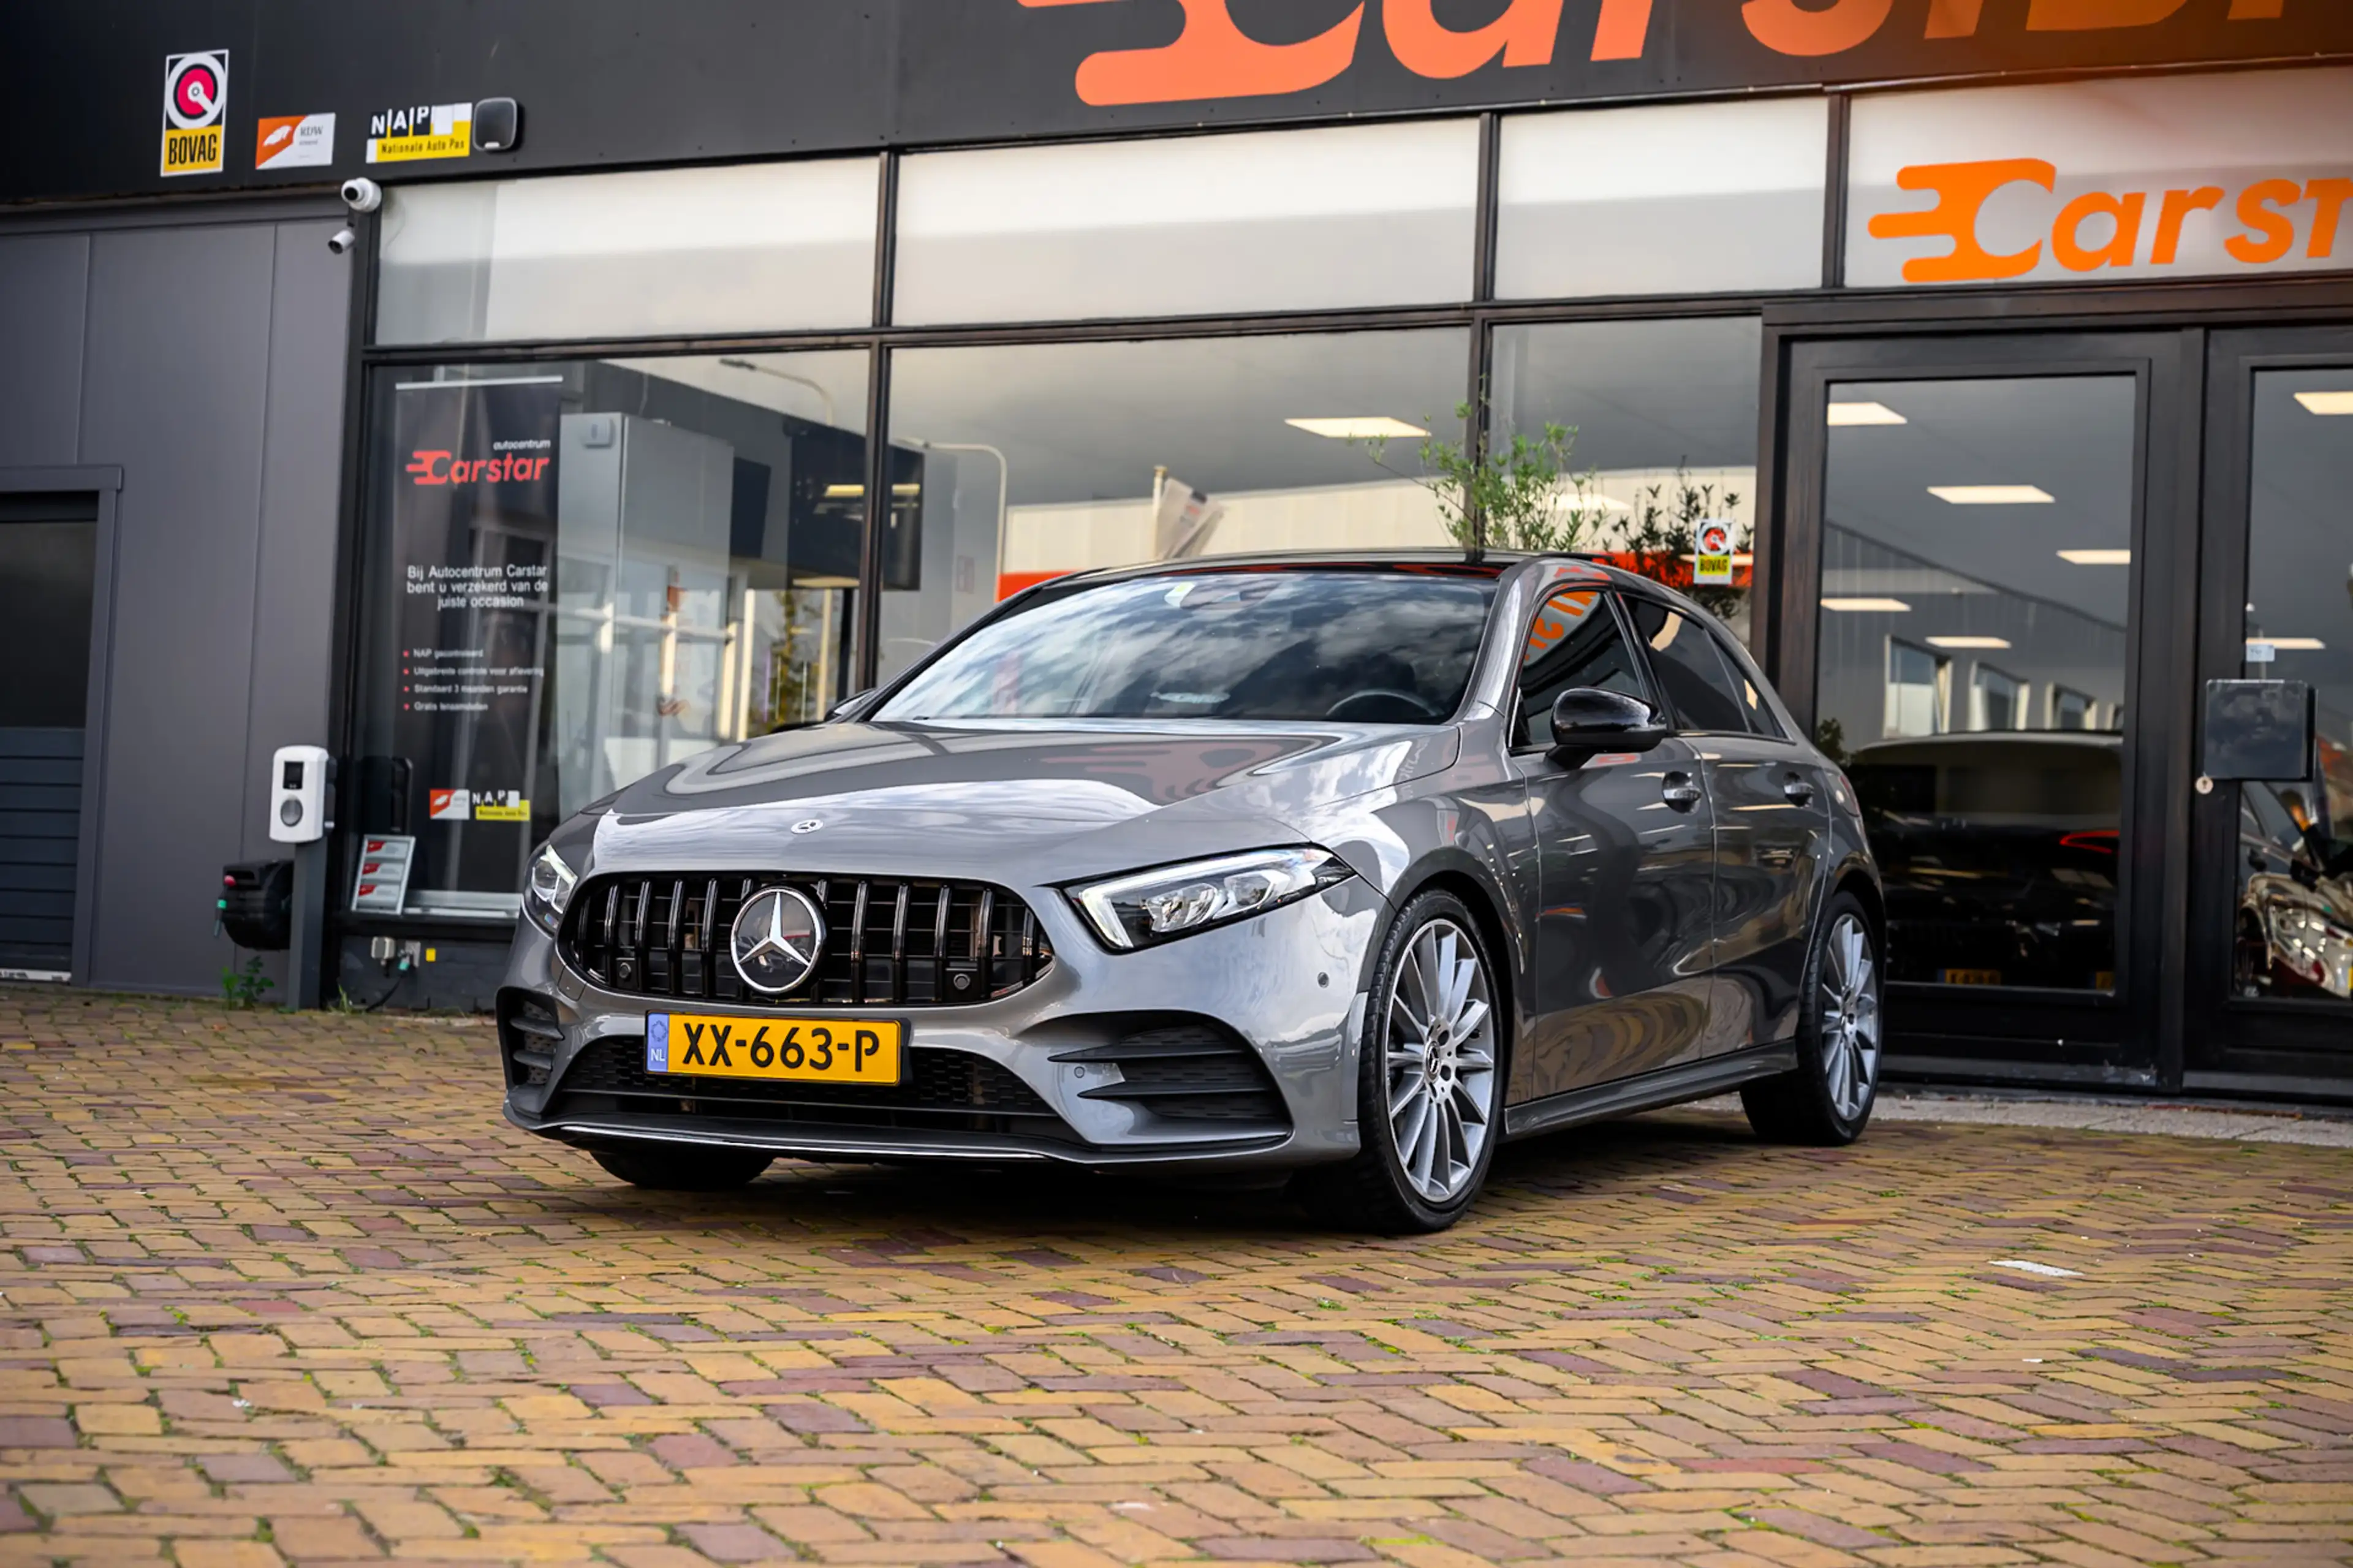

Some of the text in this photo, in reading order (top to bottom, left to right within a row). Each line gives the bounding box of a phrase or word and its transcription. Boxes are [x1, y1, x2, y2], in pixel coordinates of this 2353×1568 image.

[169, 133, 218, 165] BOVAG
[381, 138, 464, 154] Nationale Auto Pas
[493, 440, 551, 450] autocentrum
[406, 450, 550, 485] Carstar
[407, 564, 547, 581] Bij Autocentrum Carstar
[407, 580, 548, 593] bent u verzekerd van de
[438, 595, 523, 611] juiste occasion
[651, 1023, 880, 1072] NL XX-663-P
